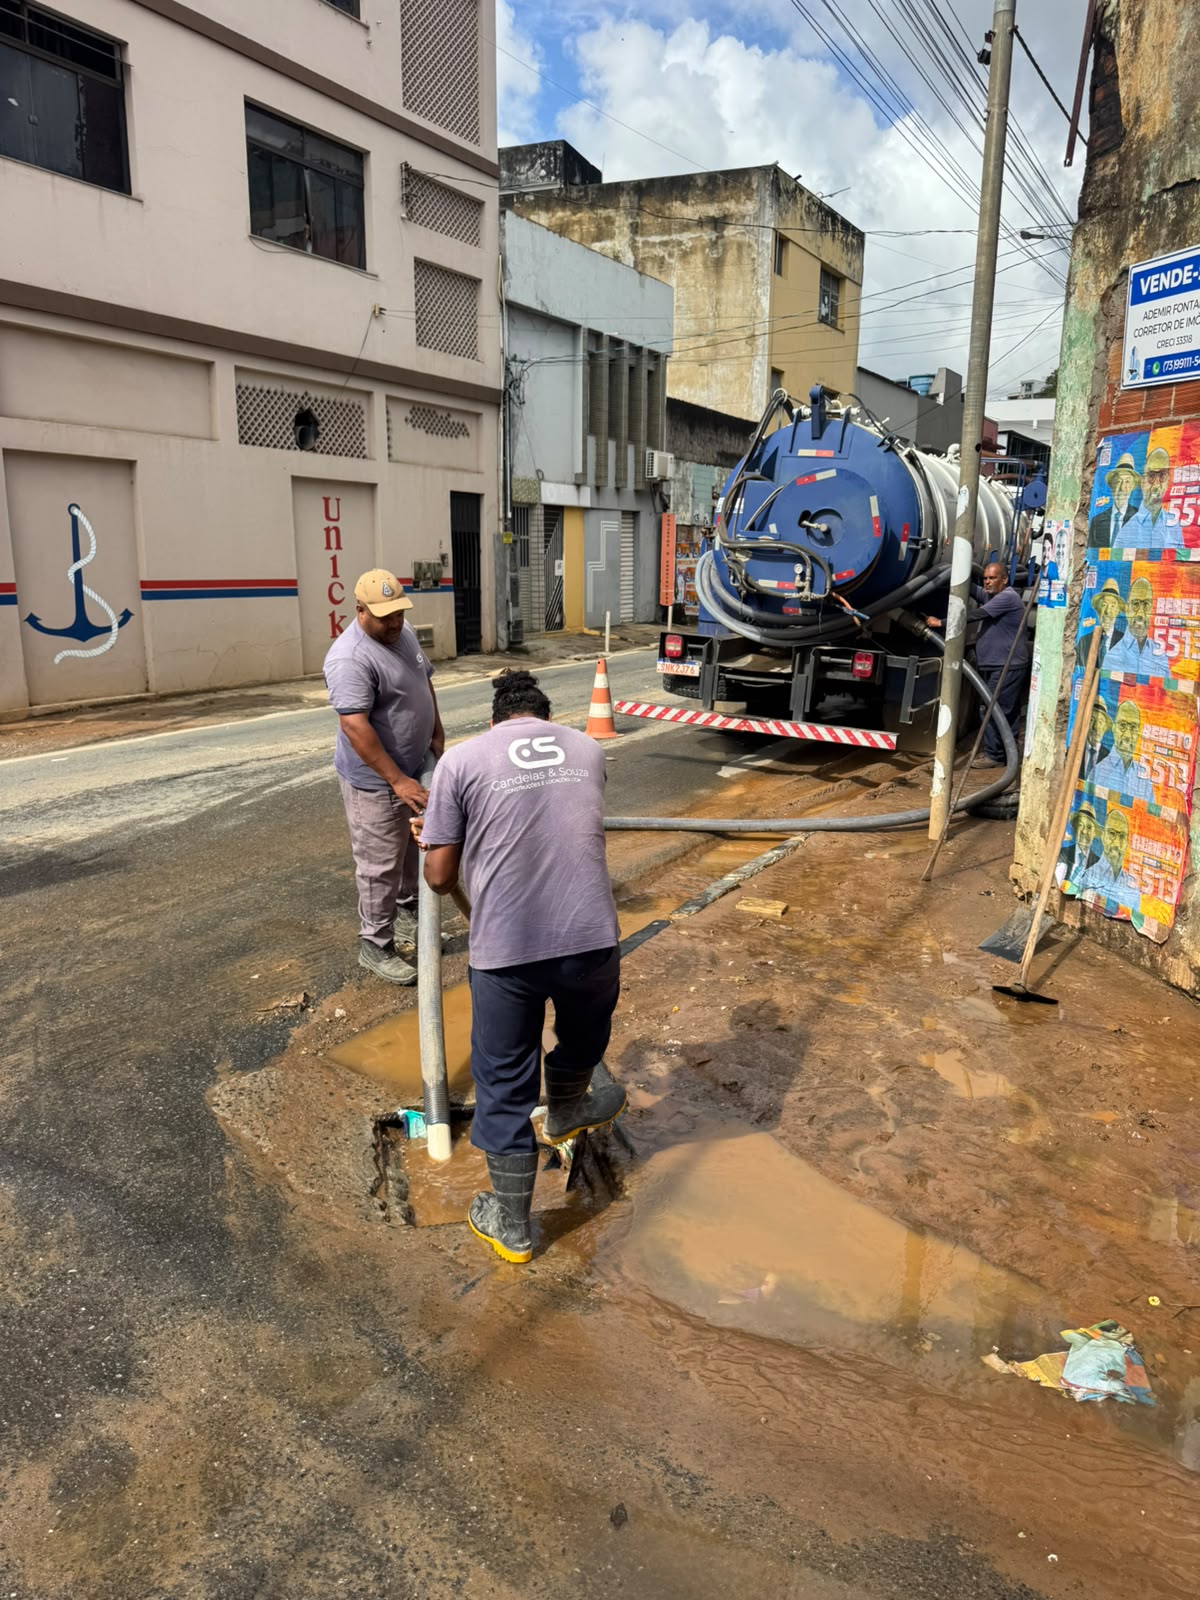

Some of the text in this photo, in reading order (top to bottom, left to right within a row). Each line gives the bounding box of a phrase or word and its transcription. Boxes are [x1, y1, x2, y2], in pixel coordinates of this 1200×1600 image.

[1140, 264, 1200, 295] VENDE-
[1142, 298, 1200, 321] ADEMIR FONTA
[1133, 321, 1175, 338] CORRETOR
[1174, 318, 1184, 331] DE
[1156, 338, 1175, 349] CRECI
[1173, 464, 1200, 484] BEB
[1166, 498, 1200, 527] 55
[548, 767, 557, 778] &
[559, 766, 589, 778] Souza
[1127, 862, 1178, 905] 5513
